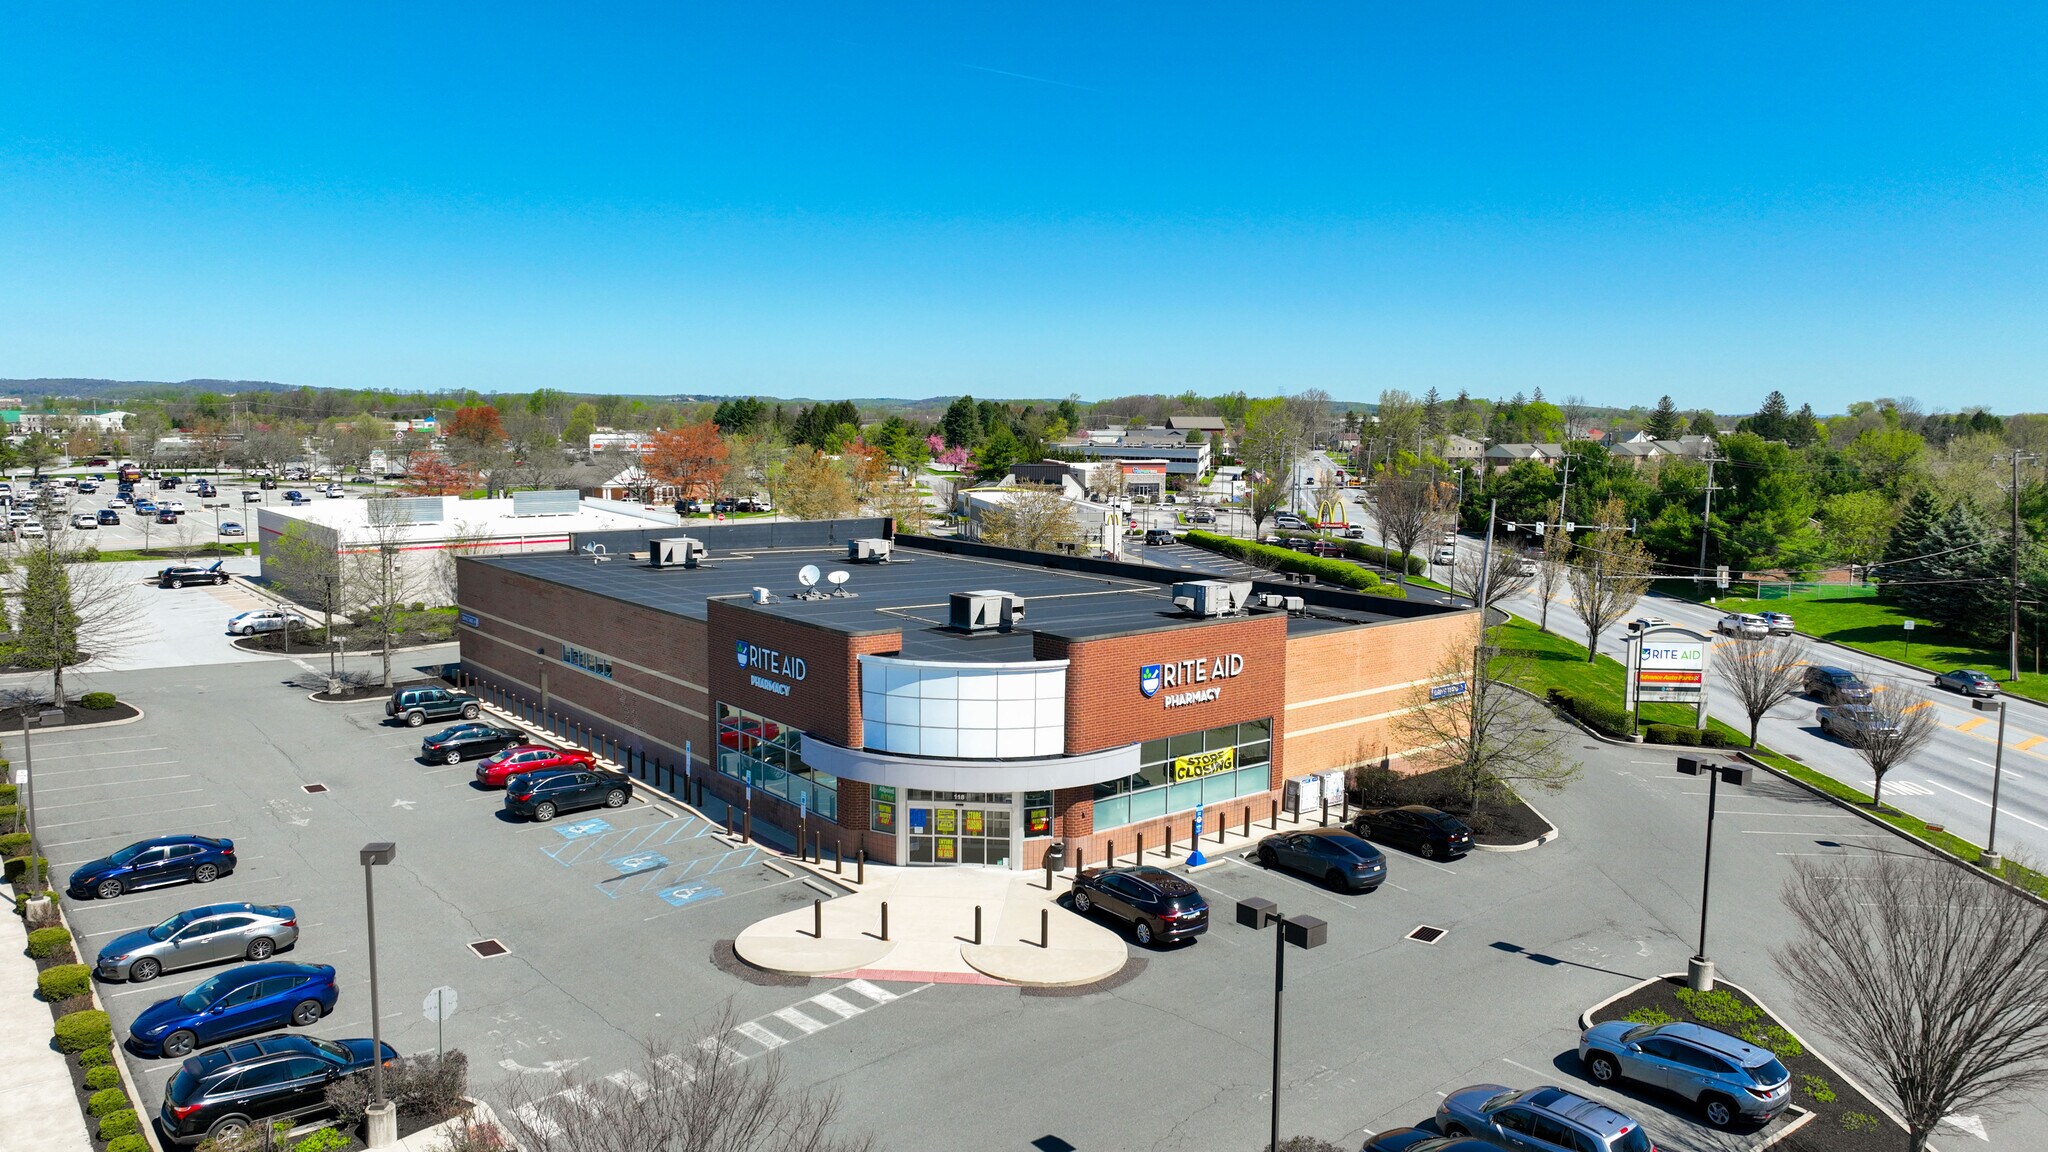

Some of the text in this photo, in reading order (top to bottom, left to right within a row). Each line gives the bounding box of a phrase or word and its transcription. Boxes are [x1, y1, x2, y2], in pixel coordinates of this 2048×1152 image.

[749, 645, 806, 680] RITE AID
[1652, 649, 1701, 660] RITE AID
[1163, 653, 1244, 689] RITE AID
[750, 674, 791, 697] PHARMACY
[1164, 687, 1221, 708] PHARMACY
[1177, 757, 1232, 780] CLOSING
[1187, 750, 1224, 766] STORE
